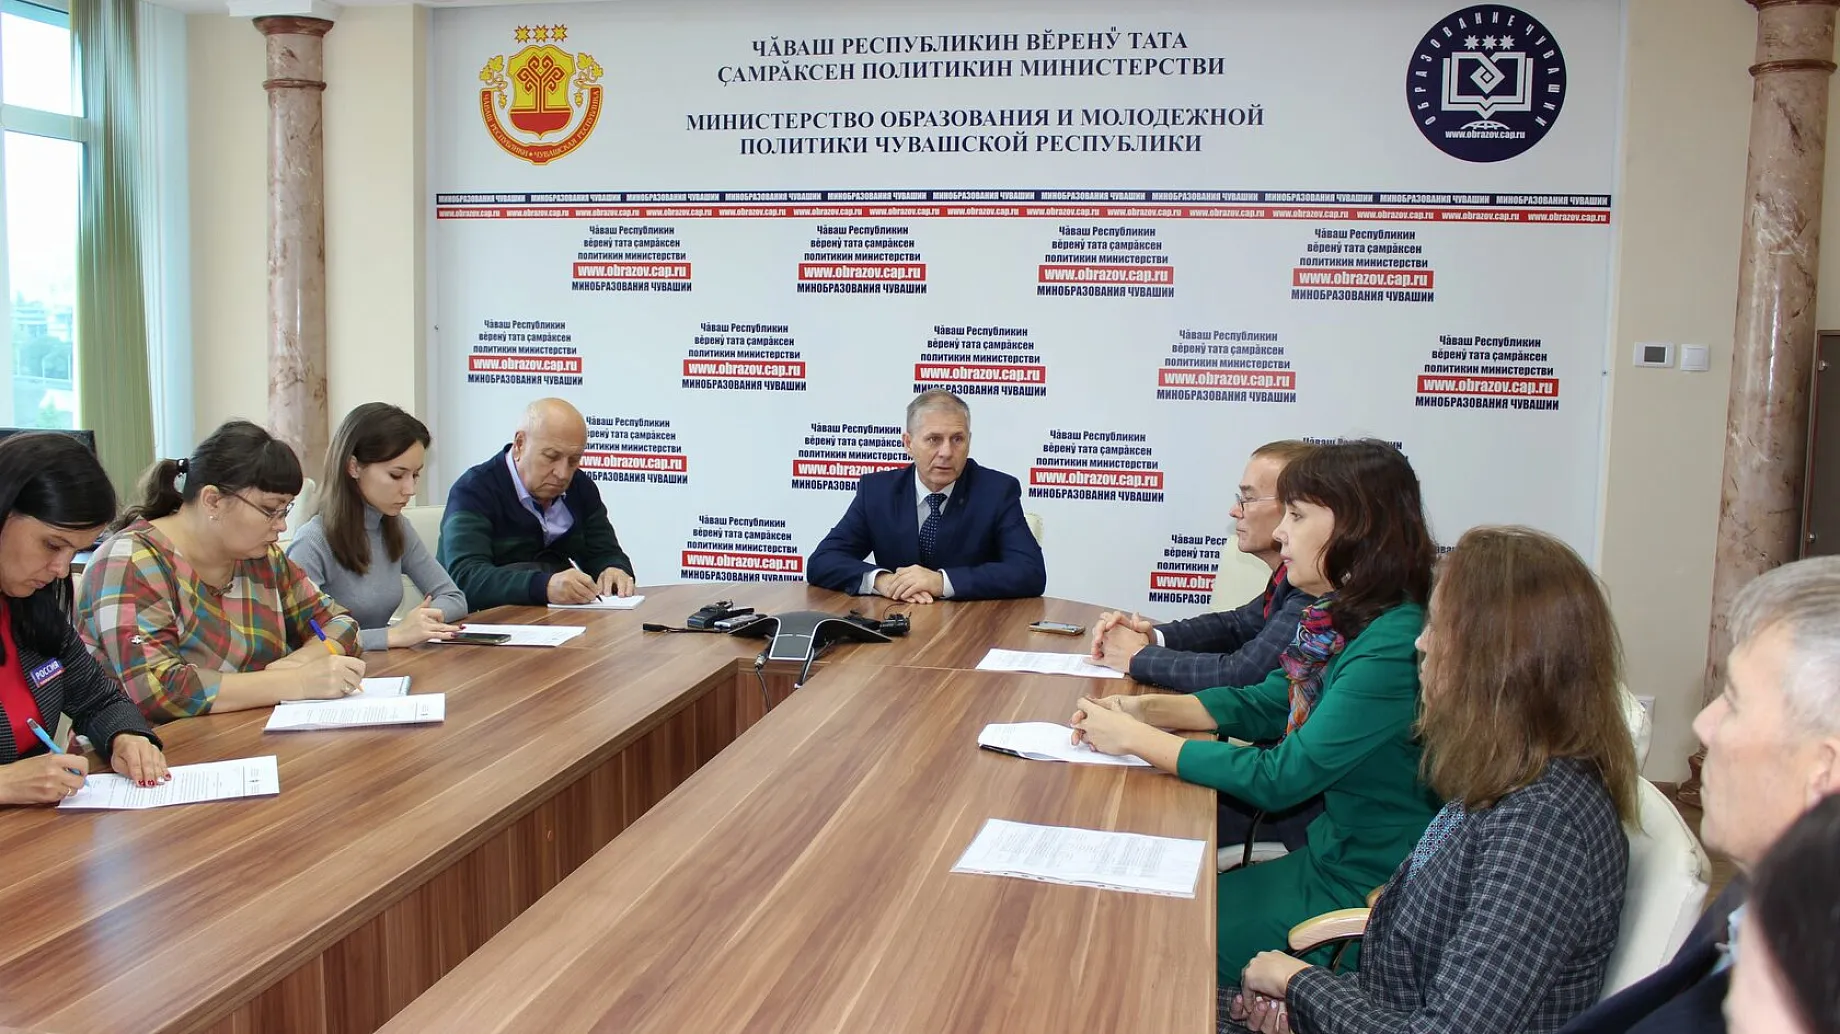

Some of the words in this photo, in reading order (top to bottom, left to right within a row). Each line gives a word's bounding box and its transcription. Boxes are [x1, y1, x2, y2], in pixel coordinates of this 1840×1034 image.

[843, 34, 1018, 54] РЕСПУБЛИКИН
[1128, 32, 1187, 49] ТАТА
[863, 60, 1012, 79] ПОЛИТИКИН
[1021, 57, 1224, 77] МИНИСТЕРСТВИ
[1415, 12, 1515, 125] ОБРАЗОВАНИЕ
[1525, 24, 1560, 126] ЧУВАШИИ
[687, 112, 874, 130] МИНИСТЕРСТВО
[881, 109, 1048, 127] ОБРАЗОВАНИЯ
[1058, 109, 1072, 125] И
[1082, 105, 1263, 128] МОЛОДЕЖНОЙ
[1445, 130, 1526, 139] www.obrazov.cap.ru
[741, 137, 867, 154] ПОЛИТИКИ
[876, 133, 1028, 153] ЧУВАШСКОЙ
[1036, 134, 1201, 153] РЕСПУБЛИКИ
[793, 208, 862, 216] www.obrazov.cap.ru
[947, 208, 1018, 216] www.obrazov.cap.ru
[1026, 208, 1100, 216] www.obrazov.cap.ru
[1272, 209, 1348, 219] www.obrazov.cap.ru
[1442, 212, 1520, 221] www.obrazov.cap.ru
[1528, 213, 1606, 222] www.obrazov.cap.ru
[619, 226, 674, 235] Республикин
[849, 226, 908, 234] Республикин
[1093, 227, 1155, 237] Республикин
[1350, 230, 1415, 240] Республикин
[1087, 241, 1107, 249] тата
[1344, 244, 1365, 252] тата
[625, 253, 686, 261] министерстви
[804, 253, 852, 261] политикин
[855, 253, 920, 262] министерстви
[1045, 255, 1096, 263] политикин
[1099, 255, 1168, 264] министерстви
[1300, 258, 1354, 266] политикин
[1356, 259, 1428, 268] министерстви
[578, 264, 686, 277] www.obrazov.cap.ru
[804, 265, 920, 279] www.obrazov.cap.ru
[1045, 267, 1168, 282] www.obrazov.cap.ru
[1300, 271, 1427, 286] www.obrazov.cap.ru
[572, 281, 649, 291] МИНОБРАЗОВАНИЯ
[651, 279, 691, 291] ЧУВАШИИ
[797, 283, 880, 293] МИНОБРАЗОВАНИЯ
[883, 284, 926, 293] ЧУВАШИИ
[1037, 285, 1126, 297] МИНОБРАЗОВАНИЯ
[1128, 287, 1174, 297] ЧУВАШИИ
[1292, 289, 1383, 301] МИНОБРАЗОВАНИЯ
[1386, 288, 1434, 302] ЧУВАШИИ
[731, 323, 788, 333] Республикин
[967, 326, 1027, 337] Республикин
[726, 337, 744, 345] тата
[962, 341, 981, 349] тата
[1475, 337, 1541, 348] Республикин
[737, 351, 800, 359] министерстви
[921, 353, 971, 362] политикин
[973, 354, 1040, 364] министерстви
[1469, 352, 1490, 360] тата
[689, 362, 800, 376] www.obrazov.cap.ru
[920, 366, 1040, 382] www.obrazov.cap.ru
[1425, 365, 1479, 374] политикин
[1481, 366, 1553, 376] министерстви
[682, 379, 762, 390] МИНОБРАЗОВАНИЯ
[764, 381, 806, 391] ЧУВАШИИ
[1424, 377, 1552, 394] www.obrazov.cap.ru
[1002, 386, 1046, 396] ЧУВАШИИ
[1416, 396, 1508, 409] МИНОБРАЗОВАНИЯ
[1511, 396, 1559, 410] ЧУВАШИИ
[615, 418, 670, 428] Республикин
[842, 424, 902, 434] Республикин
[838, 438, 857, 446] тата
[1083, 431, 1146, 442] Республикин
[622, 444, 682, 453] министерстви
[1078, 446, 1098, 454] тата
[798, 450, 847, 459] политикин
[1036, 458, 1087, 467] политикин
[1090, 459, 1158, 470] министерстви
[647, 474, 688, 484] ЧУВАШИИ
[1036, 470, 1158, 487] www.obrazov.cap.ru
[792, 480, 860, 490] МИНОБРАЗОВА
[1029, 488, 1116, 500] МИНОБРАЗОВАНИЯ
[1118, 491, 1164, 502] ЧУВАШИИ
[729, 516, 785, 529] Республикин
[724, 530, 742, 538] тата
[688, 541, 733, 550] политикин
[735, 543, 797, 554] министерстви
[1200, 550, 1220, 559] тата
[688, 553, 797, 571] www.obrazov.cap.ru
[1157, 562, 1209, 572] политикин
[681, 569, 760, 582] МИНОБРАЗОВАНИЯ
[35, 660, 60, 680] РОССИЯ
